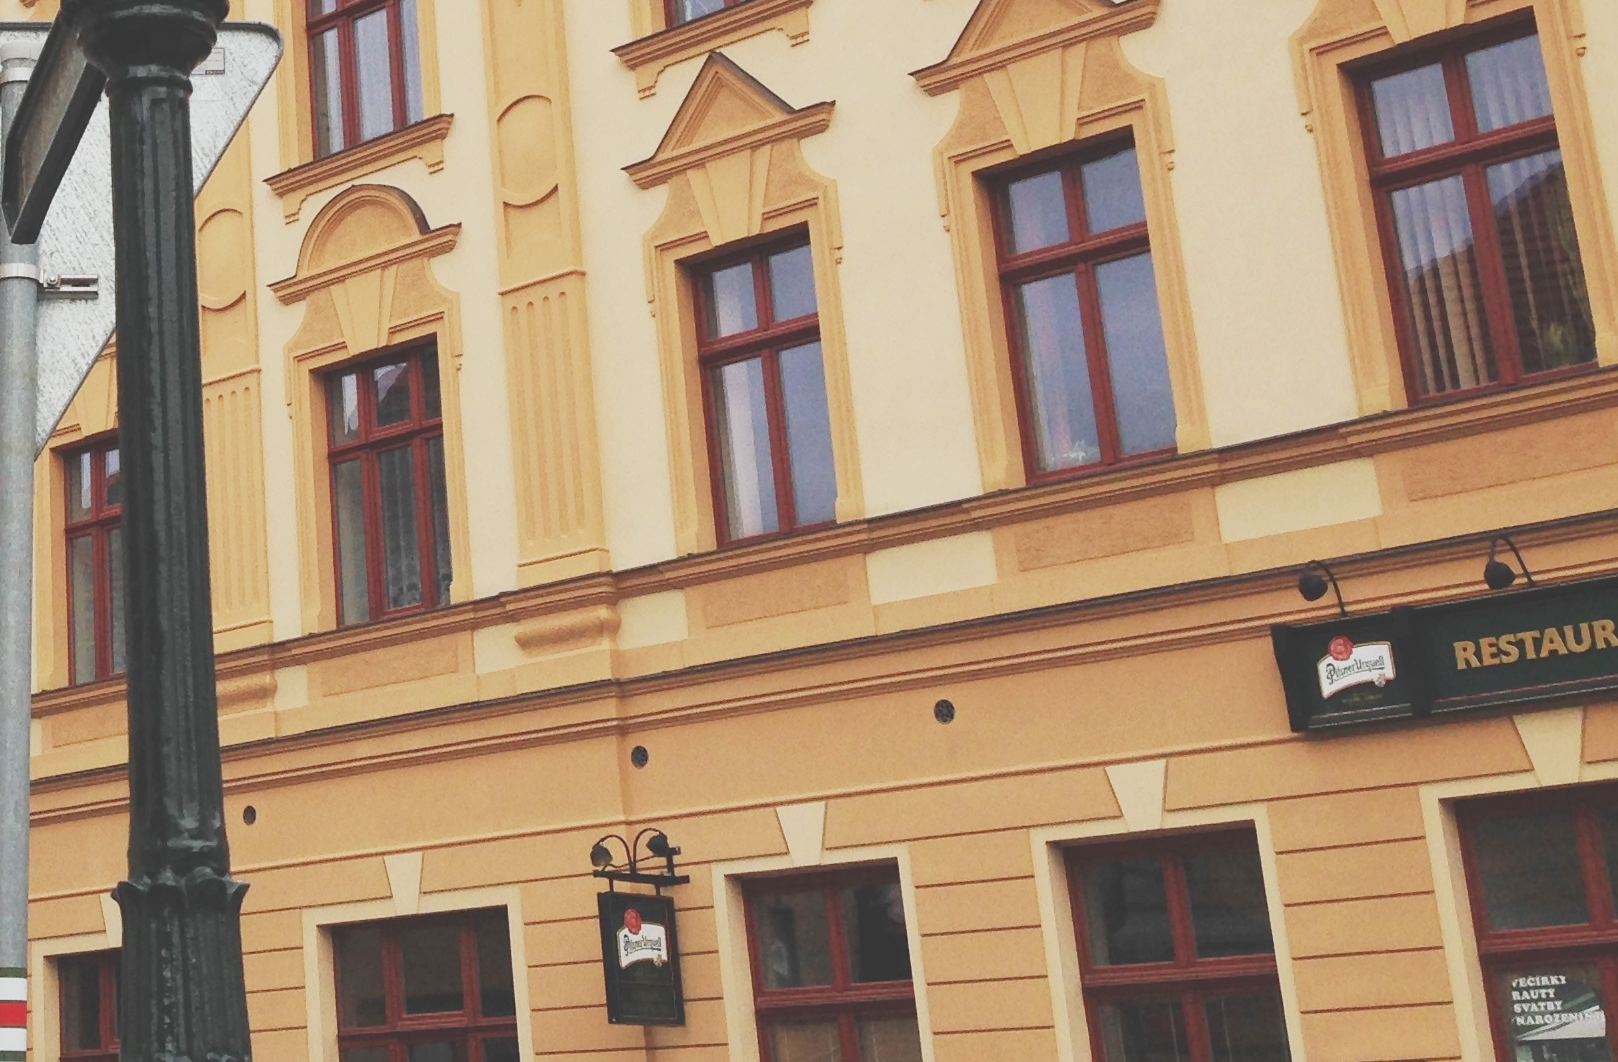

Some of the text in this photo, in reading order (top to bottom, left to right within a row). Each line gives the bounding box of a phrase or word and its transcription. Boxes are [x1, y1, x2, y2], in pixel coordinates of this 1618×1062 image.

[1454, 619, 1618, 670] RESTAUR
[1512, 988, 1556, 1000] RAUTY
[1514, 1000, 1563, 1013] SVATBY
